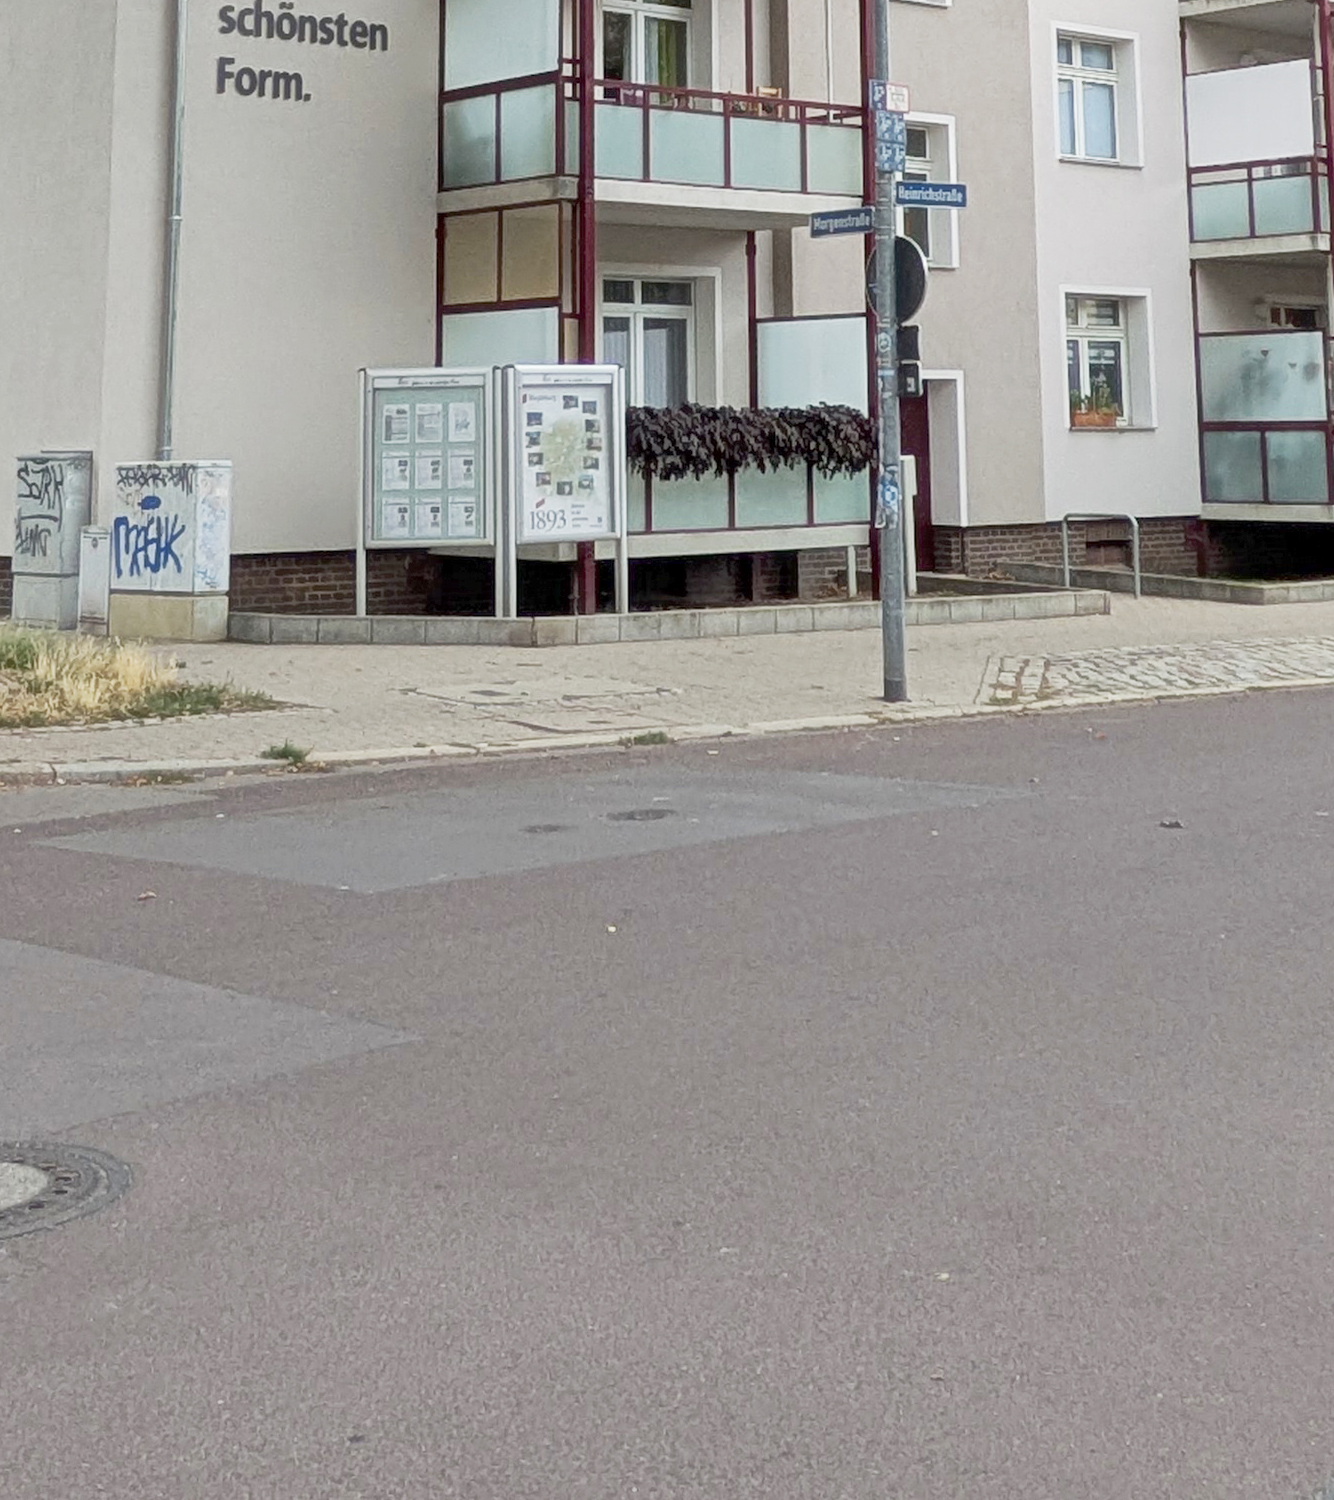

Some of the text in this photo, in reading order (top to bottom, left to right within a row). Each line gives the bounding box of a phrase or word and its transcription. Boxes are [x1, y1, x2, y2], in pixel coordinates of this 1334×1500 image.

[216, 56, 312, 102] Form.
[898, 185, 963, 203] Heinrichstraße
[813, 212, 871, 233] Morgenstraße
[530, 508, 567, 533] 1893
